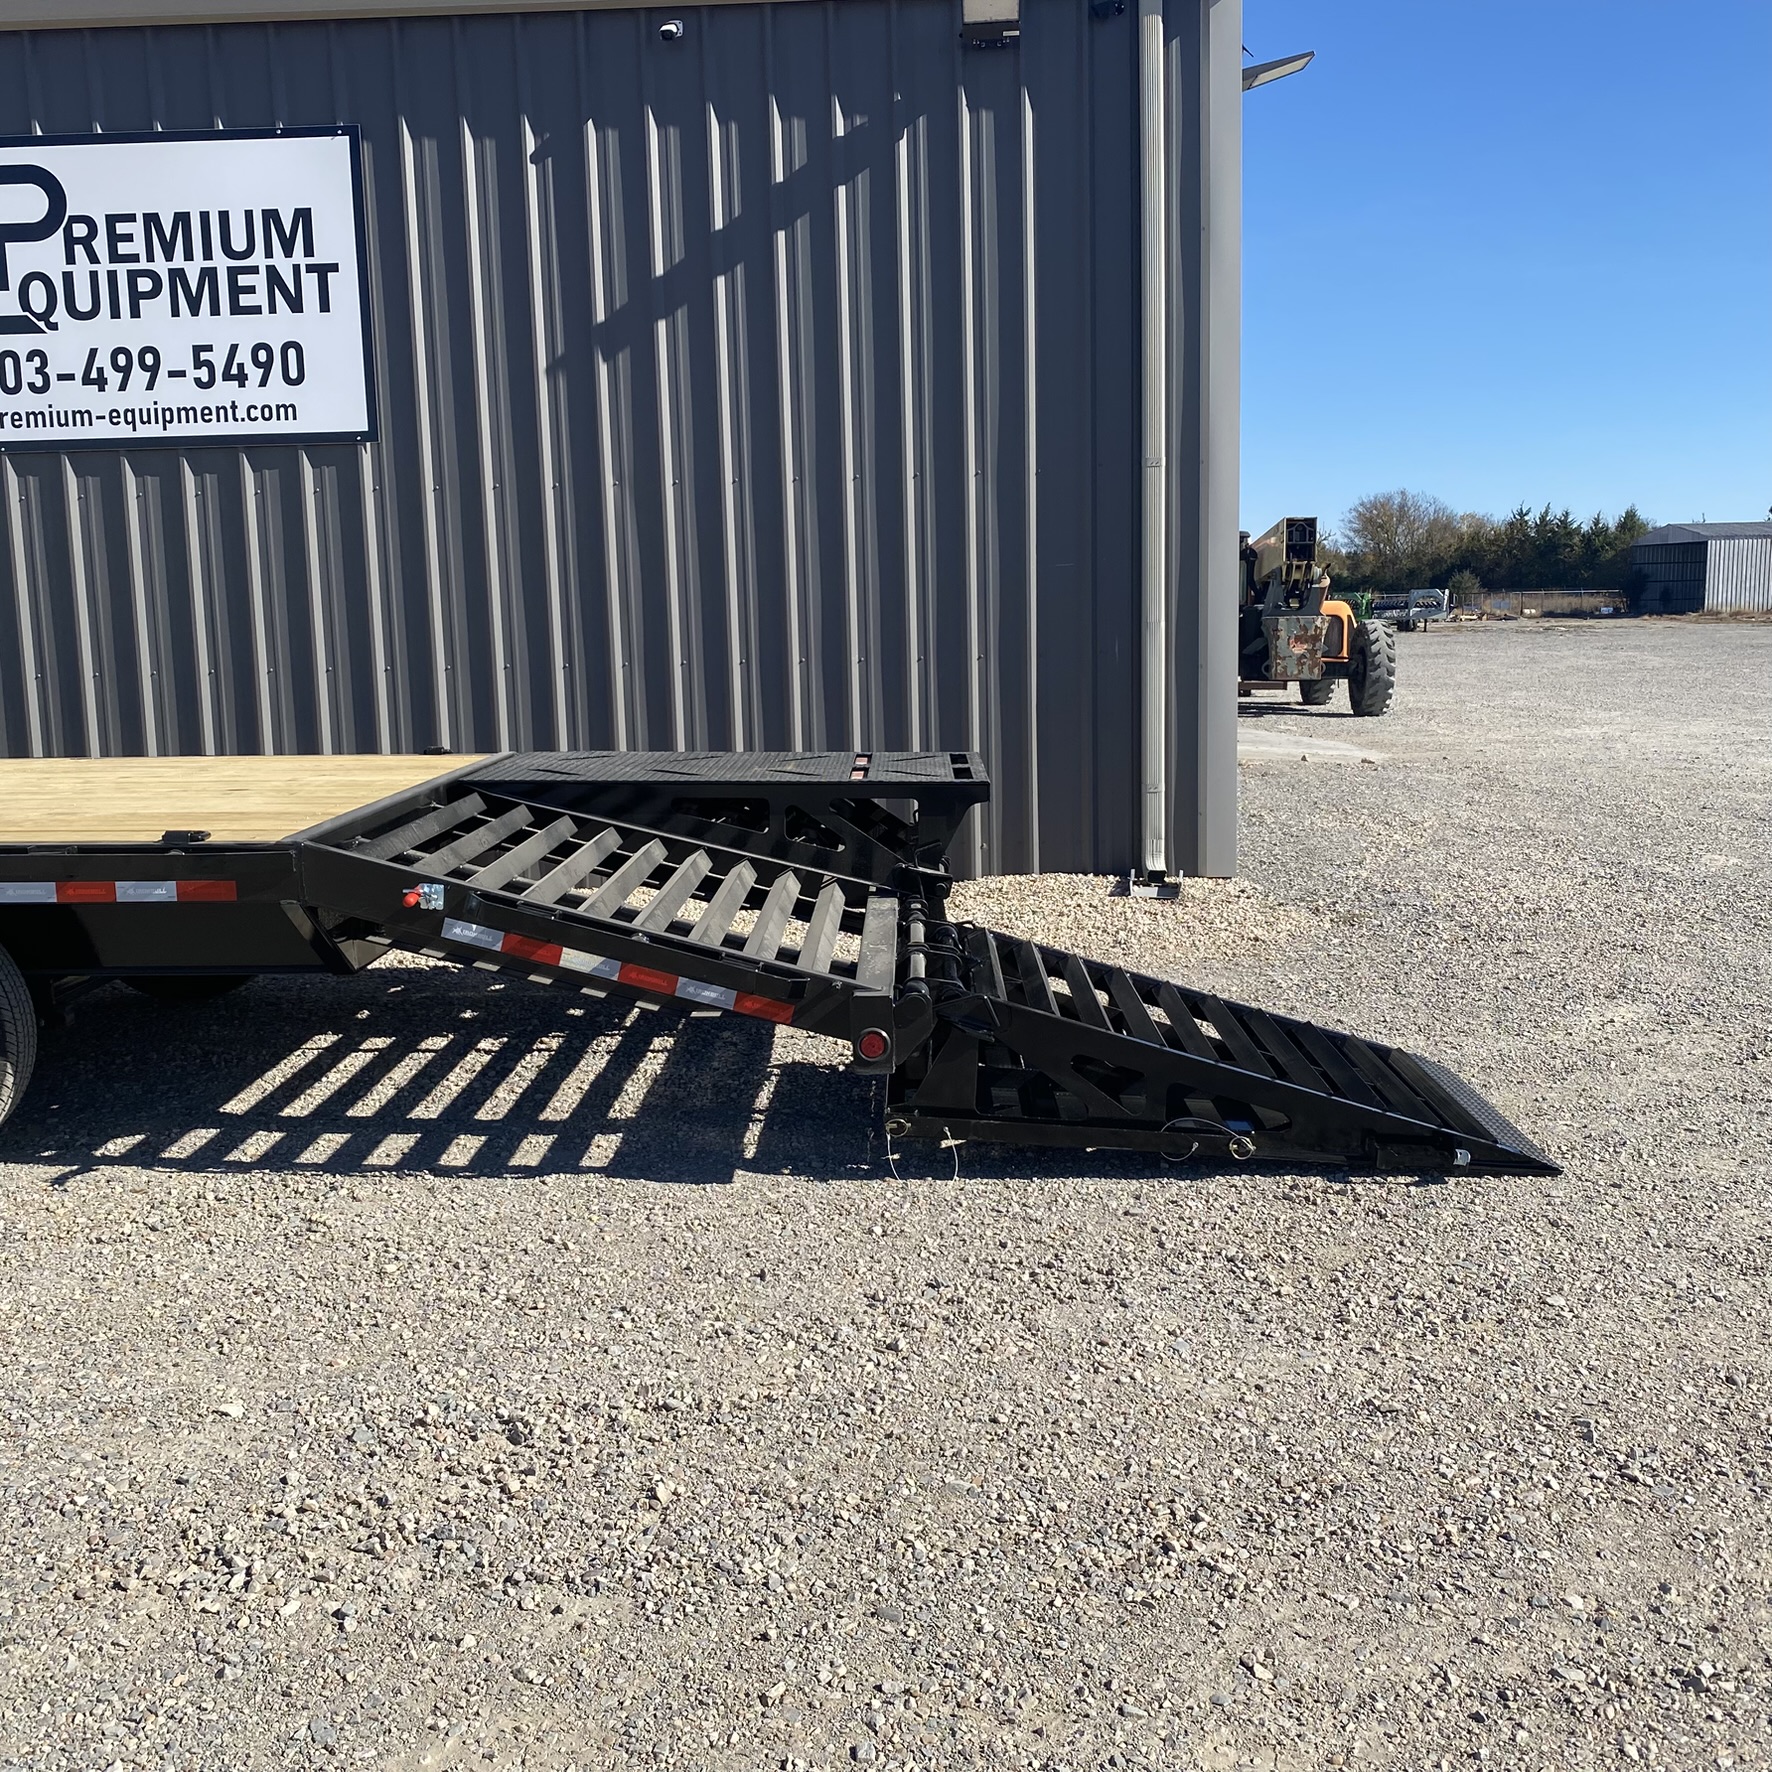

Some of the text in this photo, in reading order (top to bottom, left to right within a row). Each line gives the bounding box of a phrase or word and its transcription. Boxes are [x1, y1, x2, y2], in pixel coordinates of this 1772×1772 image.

[0, 262, 340, 334] QUIPMENT
[0, 340, 306, 395] 03-499-5490
[0, 400, 298, 432] remium-equipment.com
